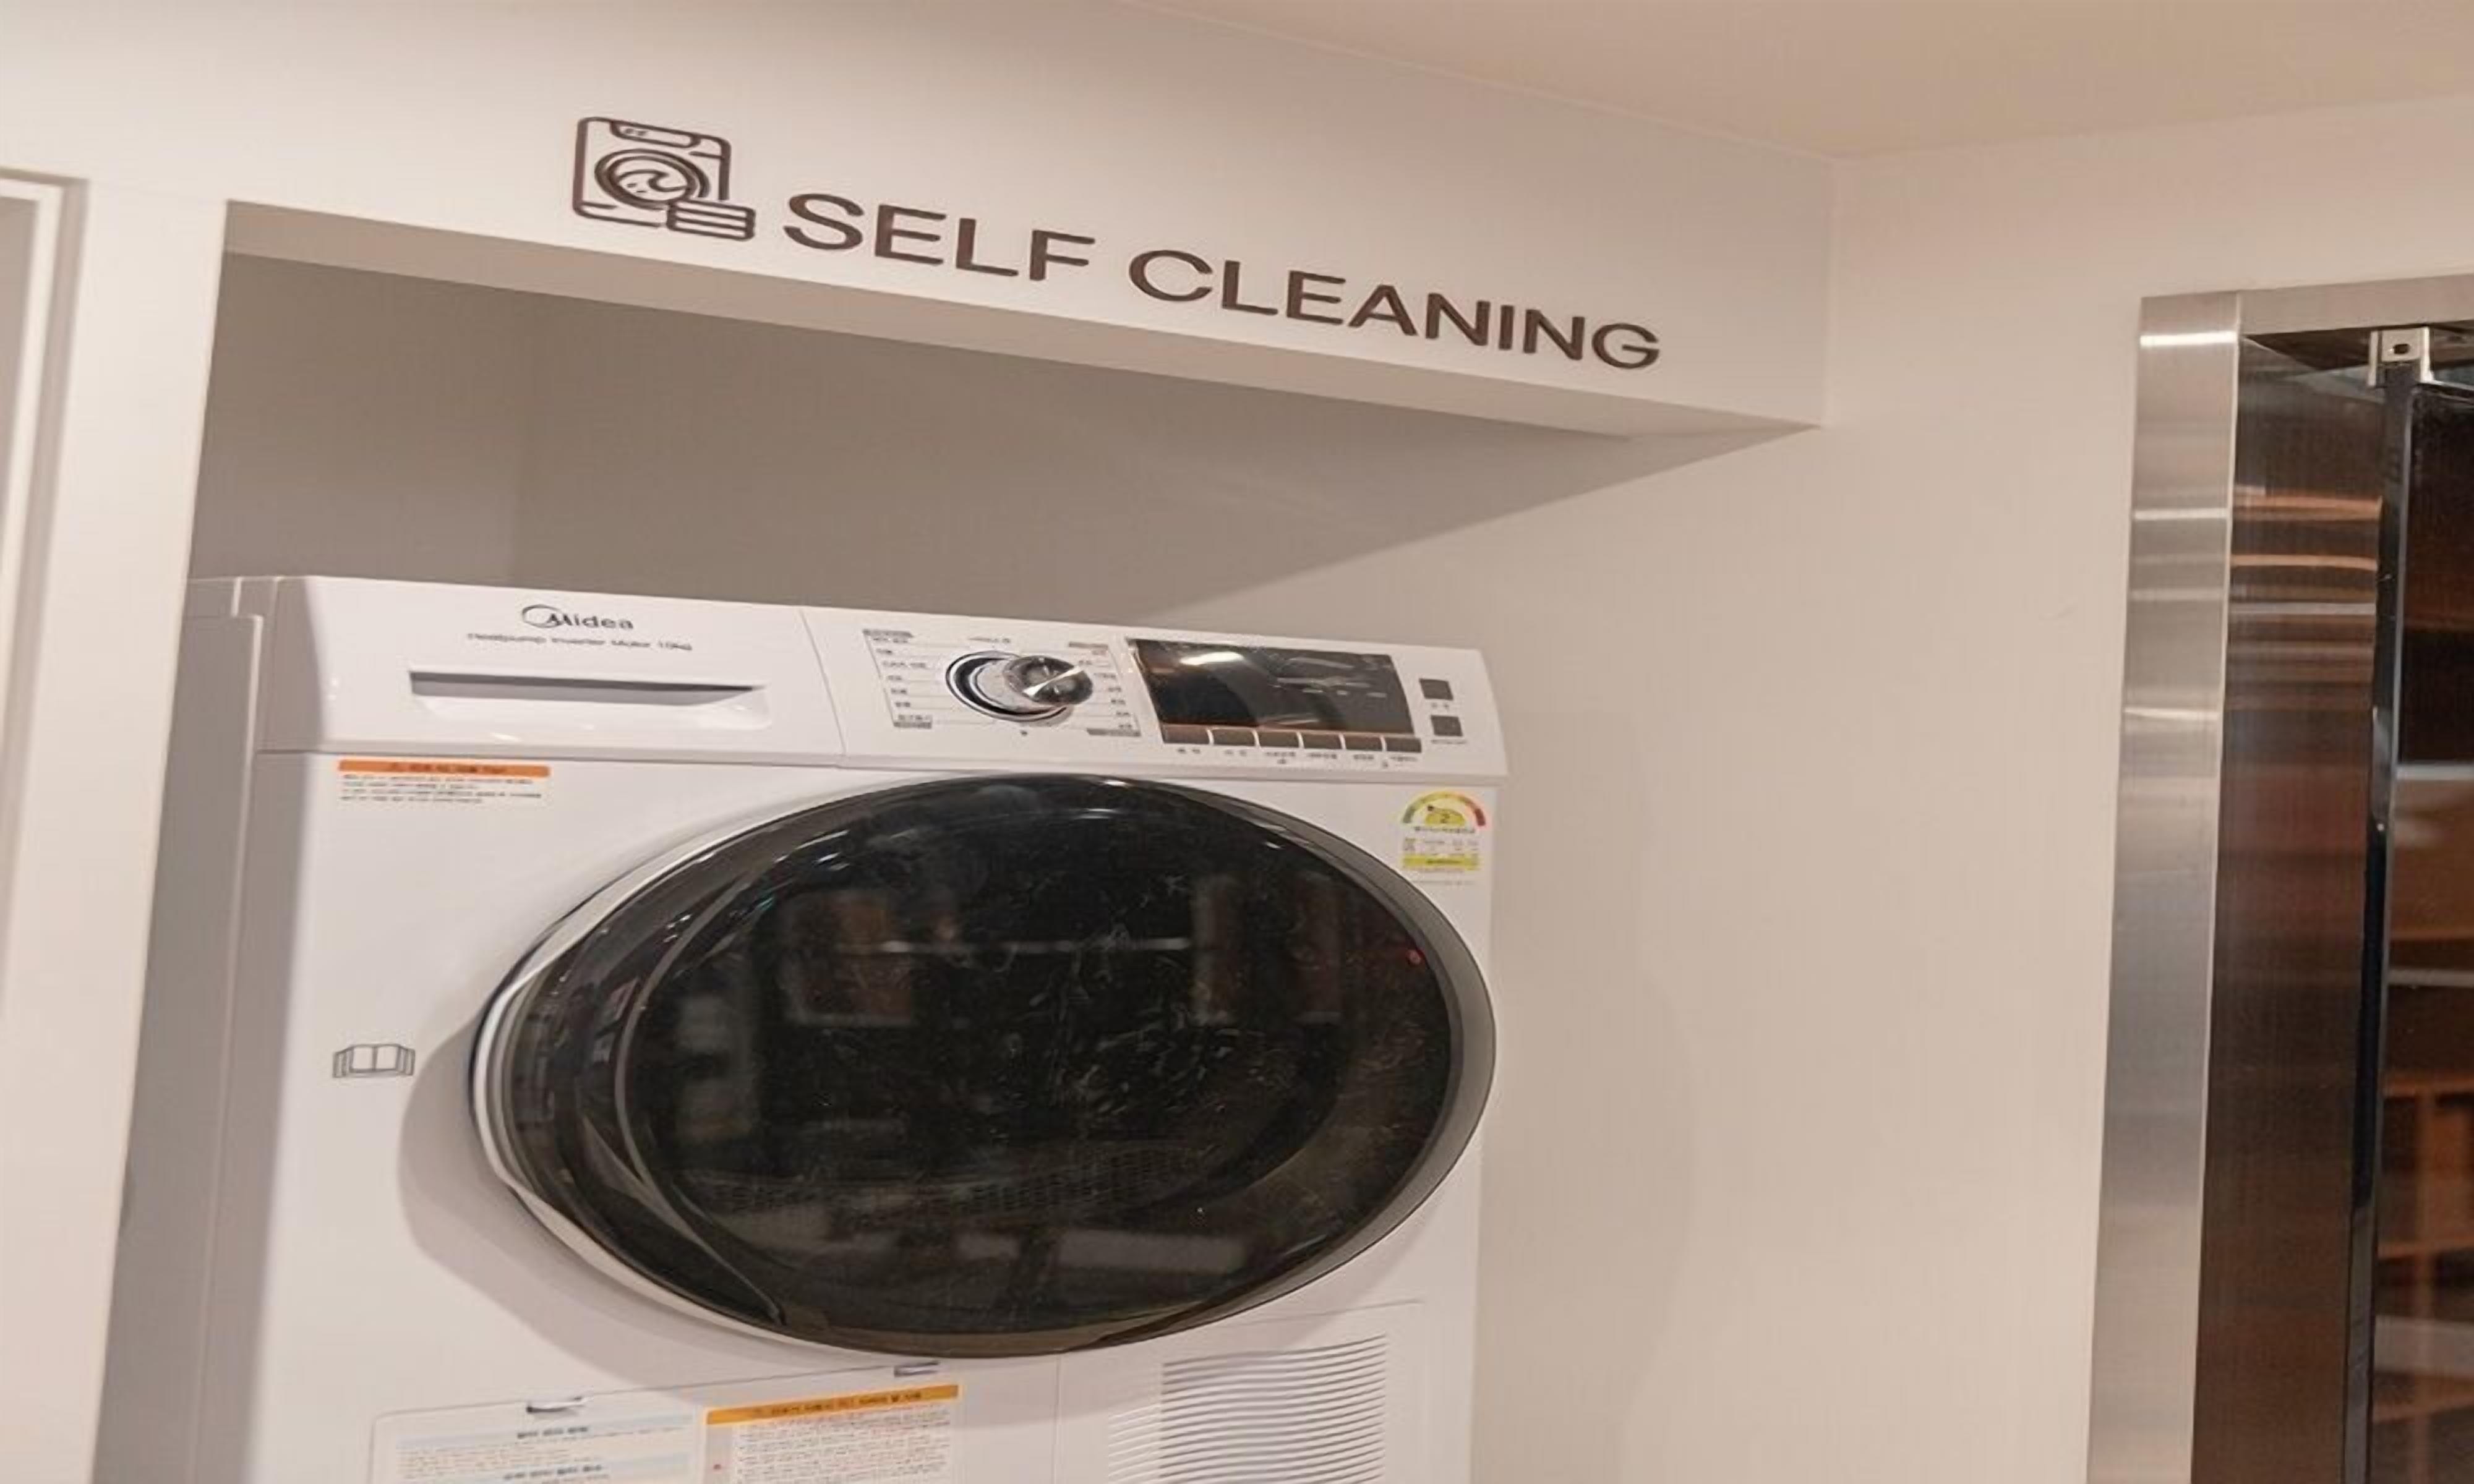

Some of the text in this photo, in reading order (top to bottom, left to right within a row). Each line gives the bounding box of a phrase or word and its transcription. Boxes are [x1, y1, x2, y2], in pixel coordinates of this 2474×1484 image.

[782, 192, 1660, 370] SELF CLEANING
[521, 604, 634, 630] Midea
